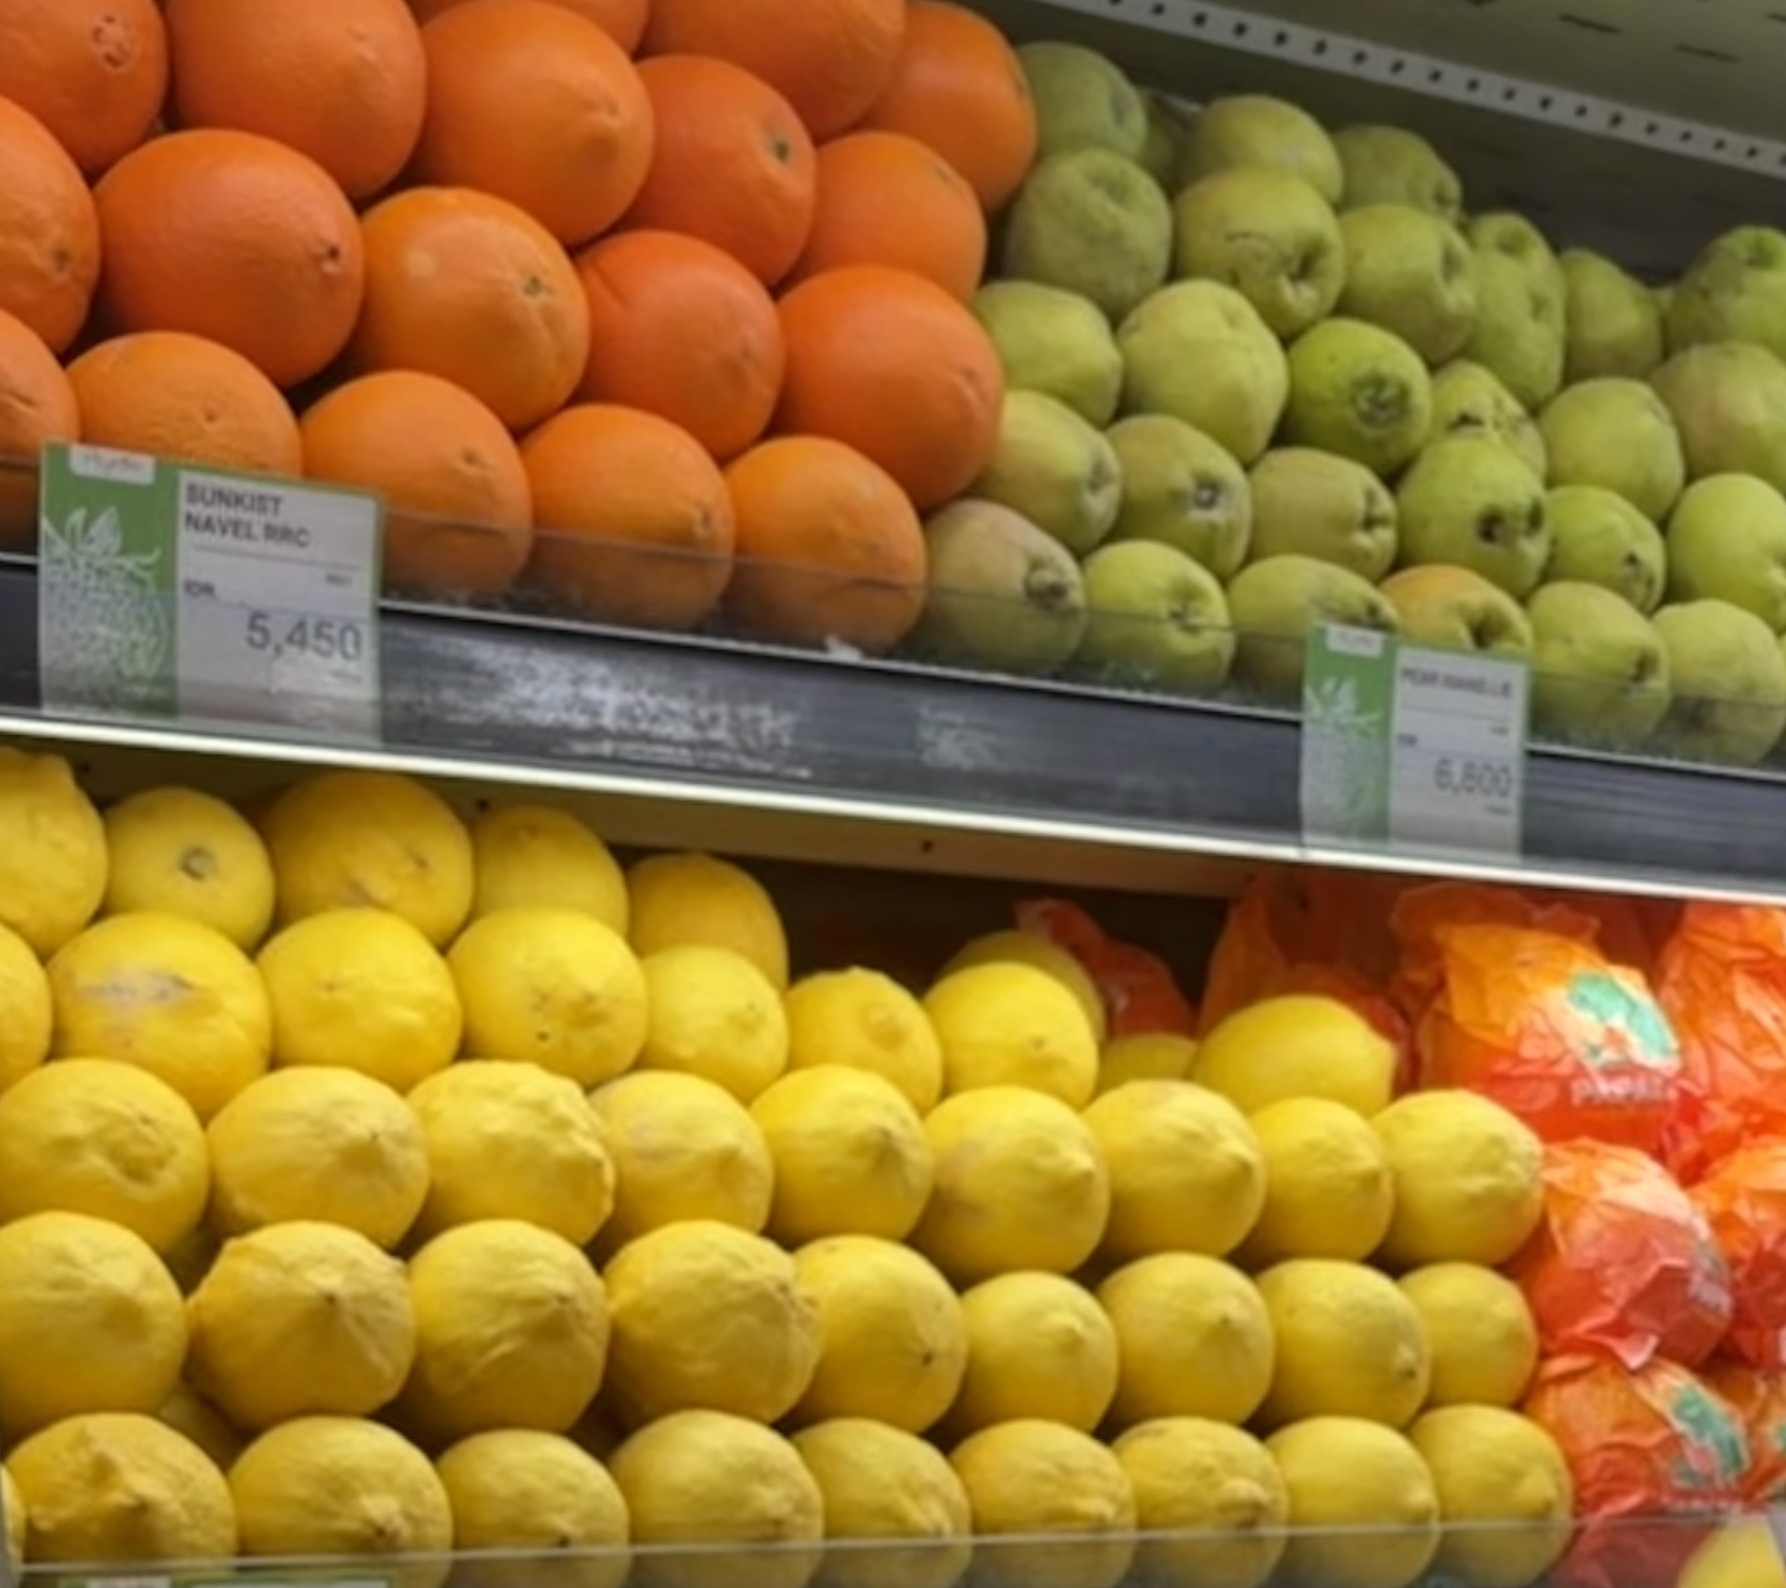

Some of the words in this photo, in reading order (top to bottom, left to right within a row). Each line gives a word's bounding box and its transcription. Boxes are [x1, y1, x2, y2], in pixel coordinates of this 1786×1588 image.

[185, 482, 283, 515] SUNKIST
[185, 511, 259, 541] NAVEL
[246, 610, 362, 662] 5,450
